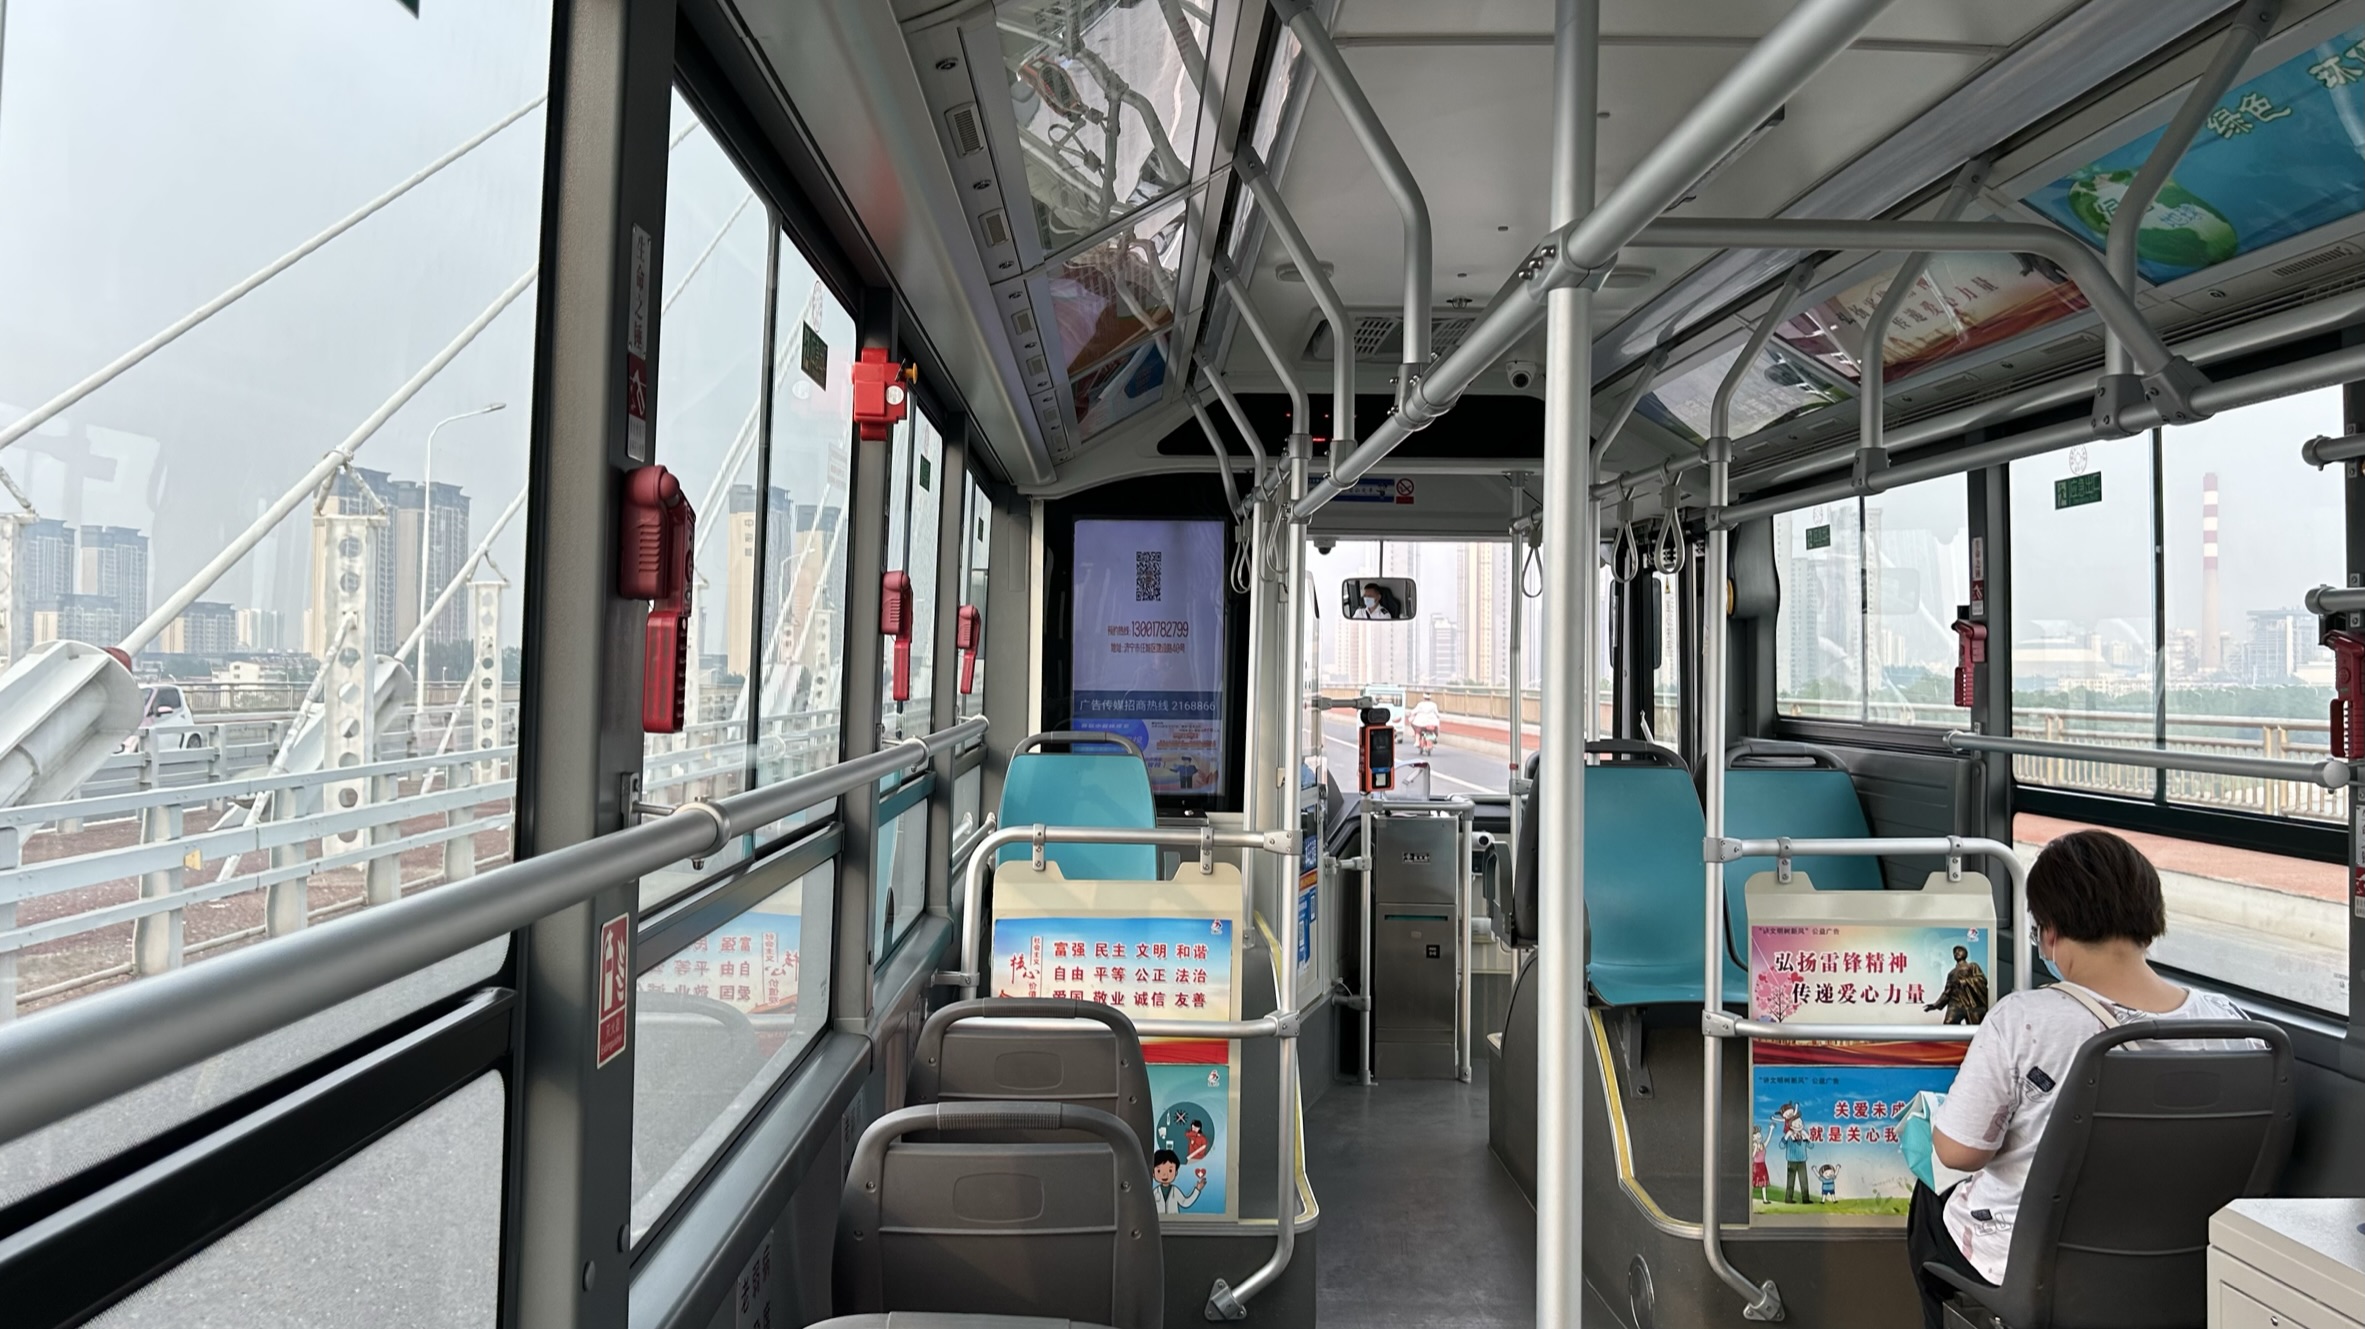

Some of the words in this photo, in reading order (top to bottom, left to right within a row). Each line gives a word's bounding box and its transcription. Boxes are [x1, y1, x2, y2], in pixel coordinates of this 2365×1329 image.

[2207, 91, 2292, 139] 绿色
[1132, 621, 1189, 638] 13001782799
[1080, 700, 1169, 712] 广告传媒招商热线
[1171, 701, 1216, 711] 2168866
[1054, 942, 1085, 957] 富强
[1095, 943, 1126, 958] 民主
[1136, 943, 1167, 958] 文明
[1176, 944, 1207, 960] 和谐
[1774, 952, 1908, 973] 弘扬雷锋精神
[1054, 966, 1084, 981] 自由
[1094, 967, 1126, 982] 平等
[1135, 967, 1166, 982] 公正
[1175, 968, 1207, 983] 法治
[1093, 990, 1125, 1006] 敬业
[1134, 991, 1166, 1007] 诚信
[1175, 992, 1206, 1008] 友善
[1792, 983, 1925, 1004] 传递爱心力量
[1809, 1127, 1899, 1143] 就是关心我
